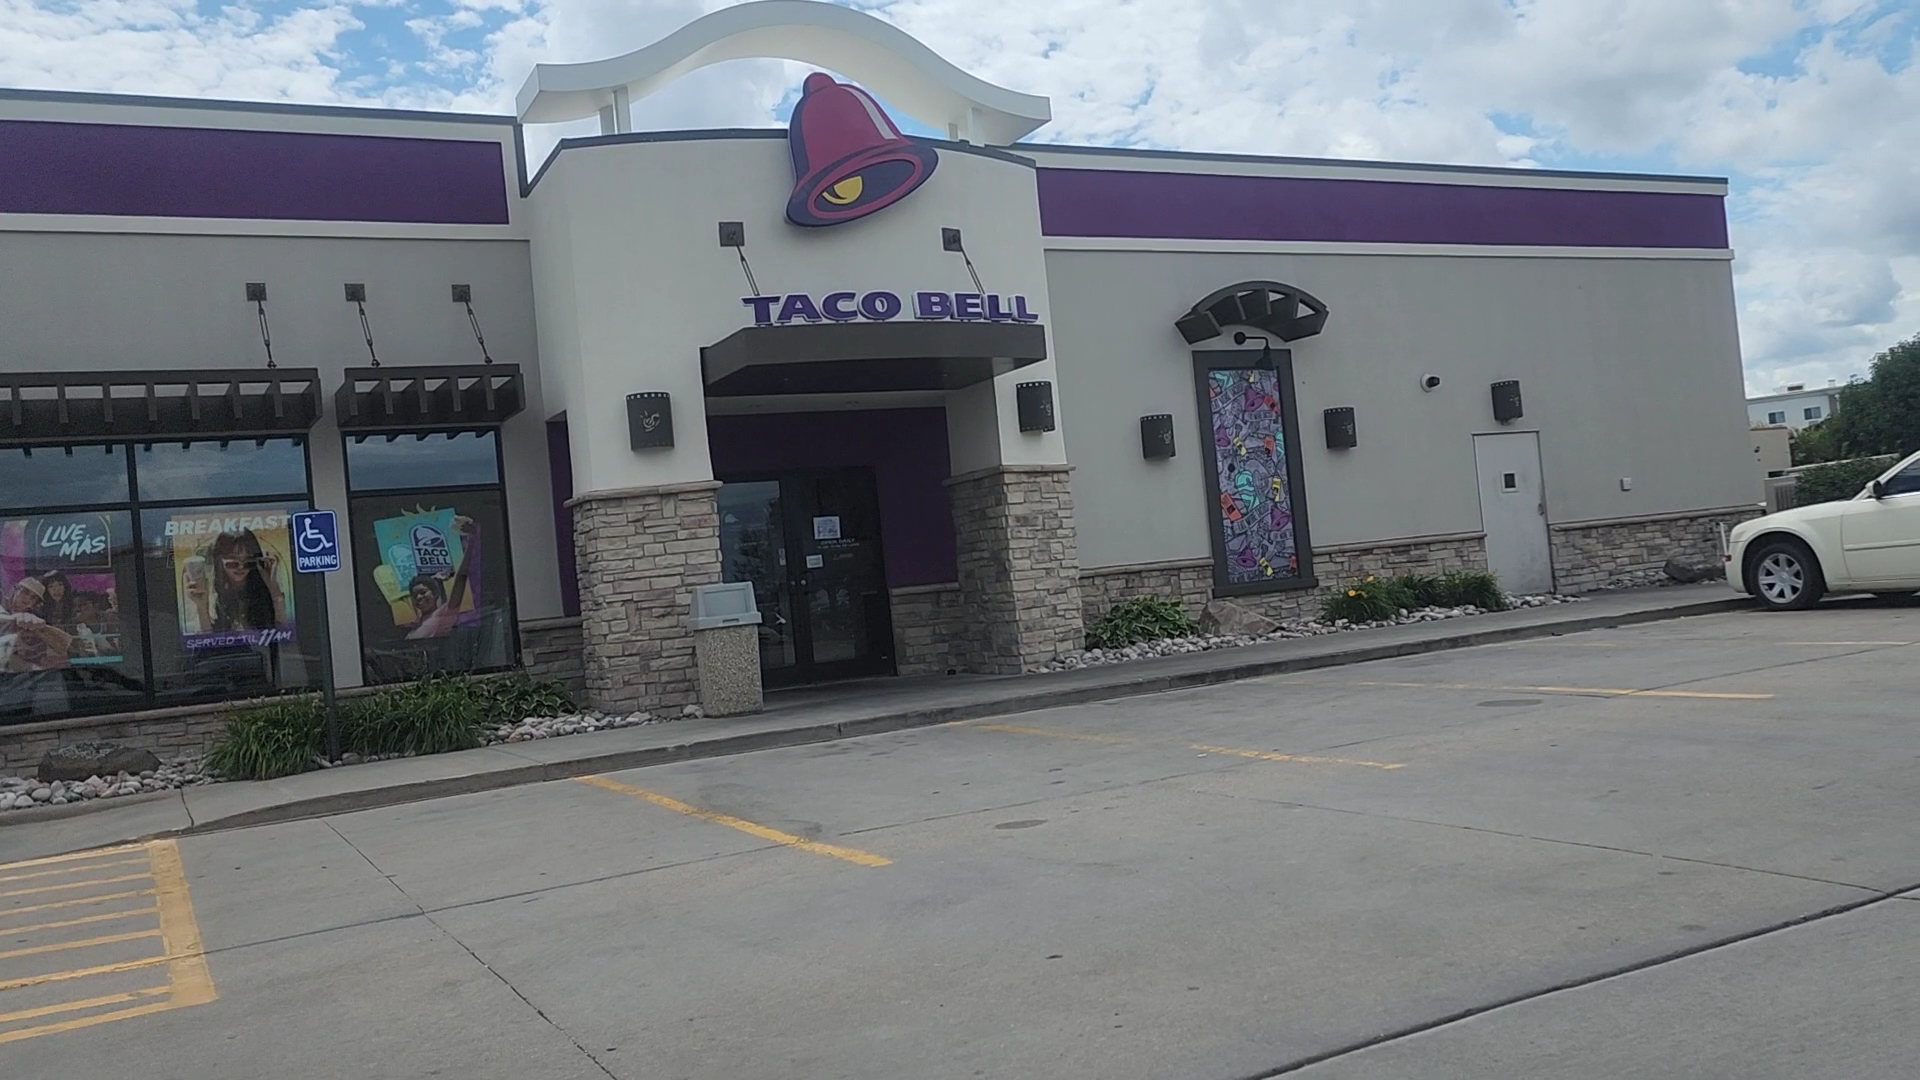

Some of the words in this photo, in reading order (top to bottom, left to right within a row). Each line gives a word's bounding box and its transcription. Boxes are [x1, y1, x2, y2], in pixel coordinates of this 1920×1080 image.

[740, 290, 902, 325] TACO
[911, 291, 1039, 323] BELL
[165, 515, 291, 536] BREAKFAST
[41, 523, 86, 548] LIVE
[416, 548, 449, 557] TACO
[299, 554, 337, 568] PARKING
[420, 557, 451, 566] BELL
[186, 637, 235, 649] SERVED
